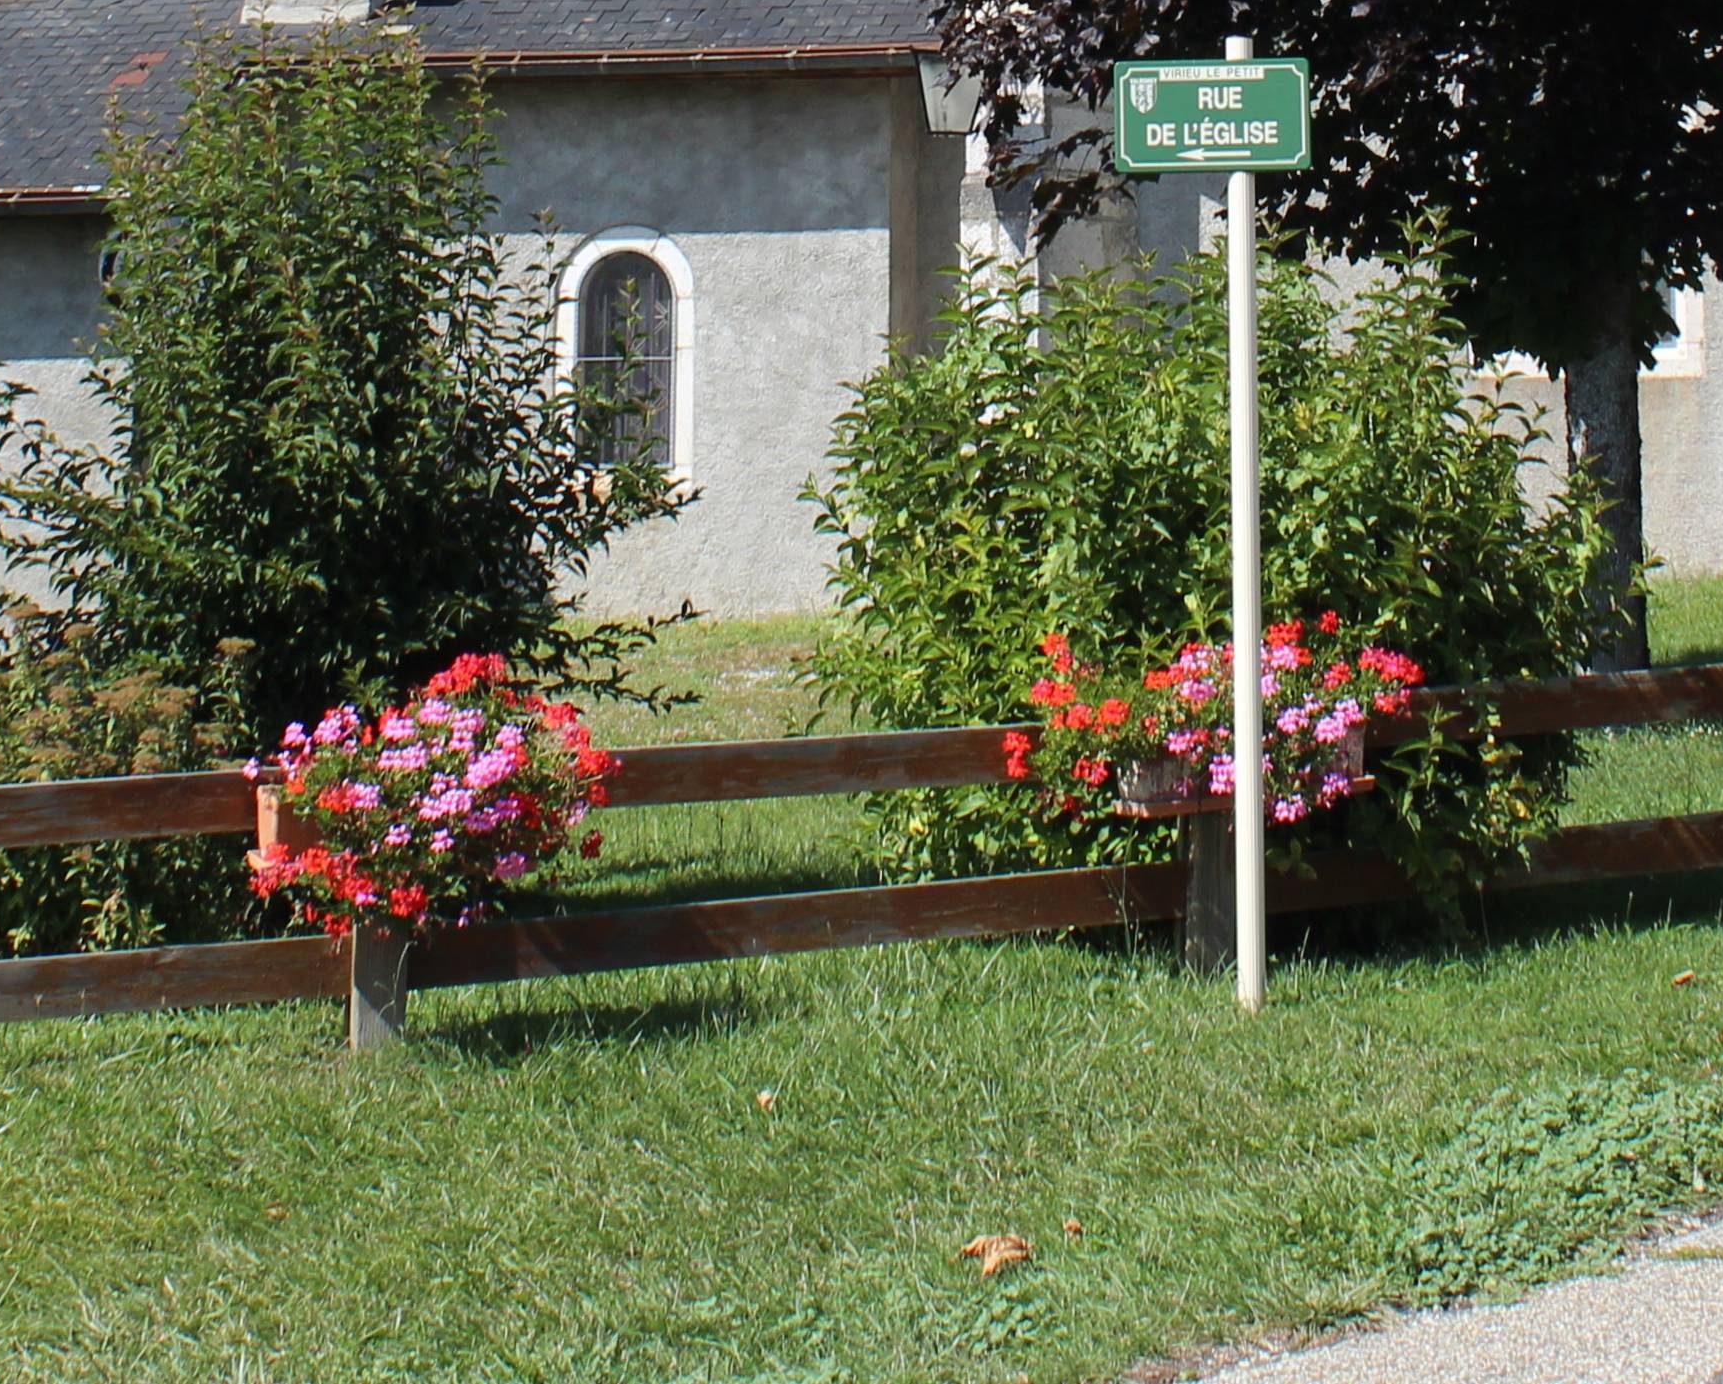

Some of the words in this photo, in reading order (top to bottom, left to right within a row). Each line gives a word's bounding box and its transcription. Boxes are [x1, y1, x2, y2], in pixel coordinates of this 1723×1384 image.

[1163, 68, 1200, 78] VIRIEU
[1206, 68, 1220, 78] LE
[1227, 67, 1260, 77] PETIT
[1198, 86, 1243, 110] RUE
[1146, 123, 1176, 147] DE
[1183, 116, 1279, 146] L'ÉGLISE
